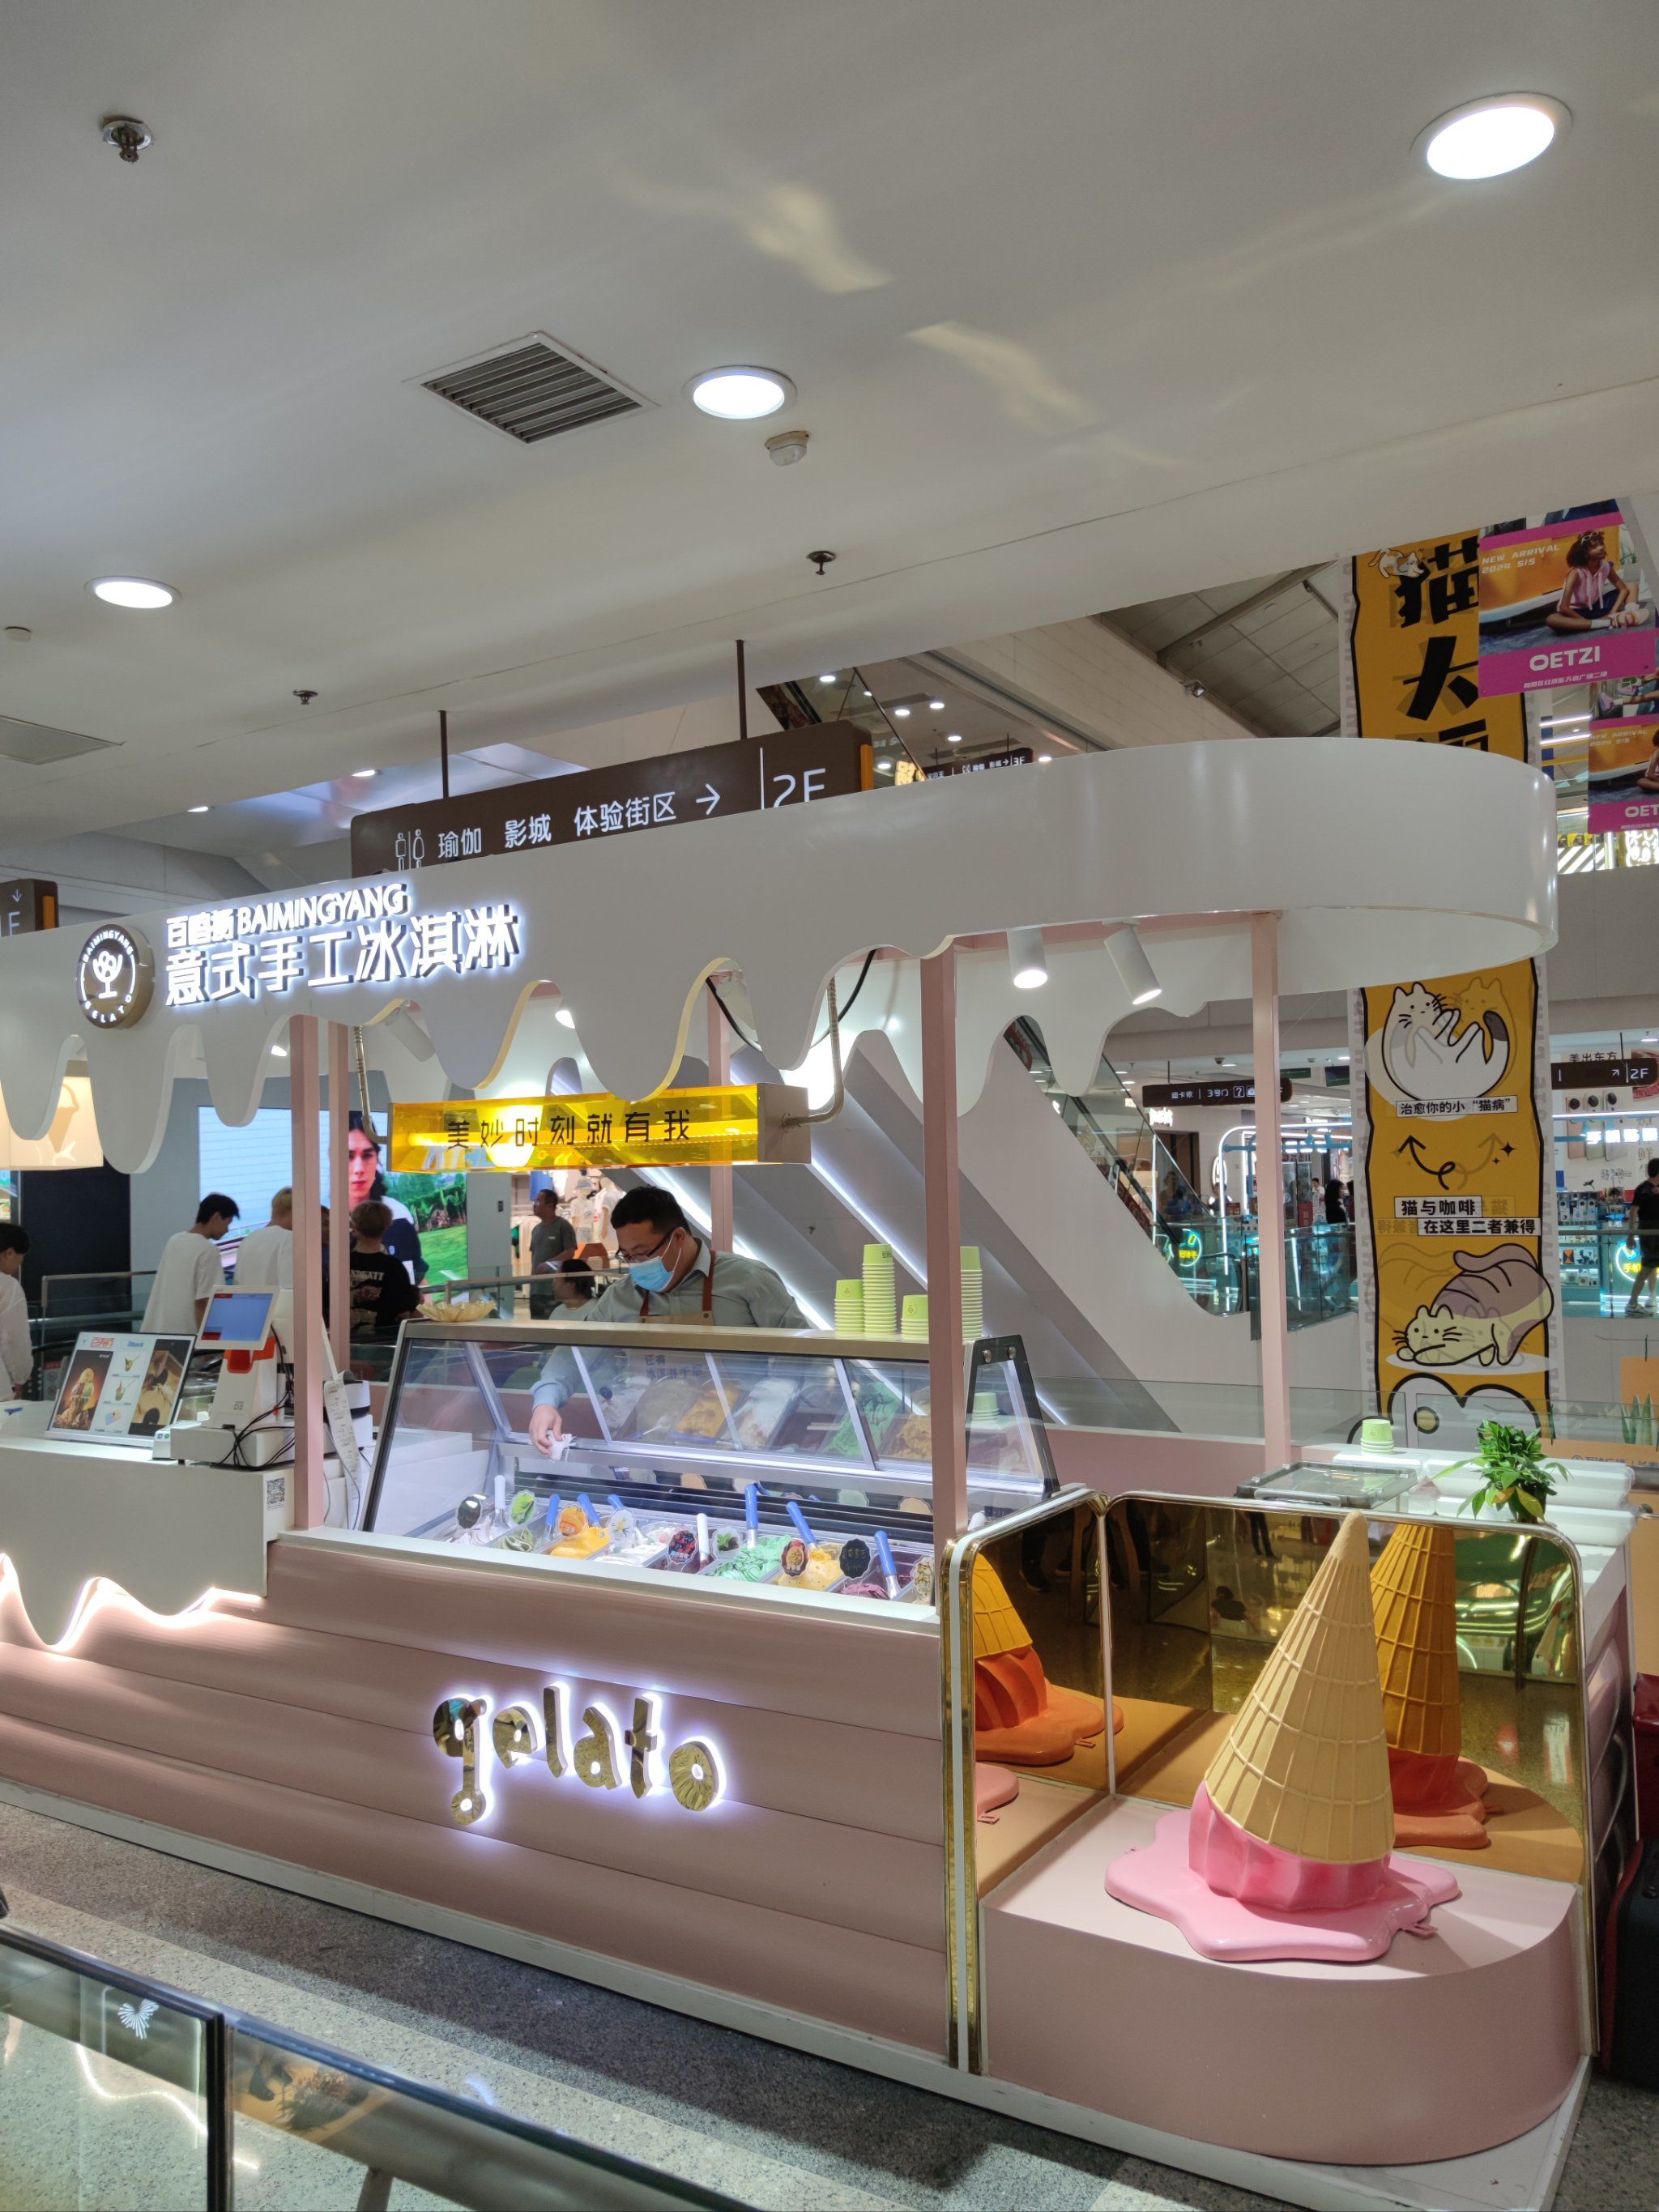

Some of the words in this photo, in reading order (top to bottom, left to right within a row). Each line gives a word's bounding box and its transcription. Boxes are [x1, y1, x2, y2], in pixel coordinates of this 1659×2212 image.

[1482, 554, 1505, 565] NEW
[1512, 543, 1560, 559] ARRIVAL
[1482, 563, 1511, 574] 2024
[1529, 646, 1601, 671] OETZI
[1013, 756, 1026, 765] 3F
[438, 828, 482, 859] 瑜伽
[505, 813, 552, 850] 影城
[574, 791, 676, 837] 体验街区
[773, 768, 826, 808] 2F
[238, 882, 407, 935] BAIMINGYANG
[83, 929, 134, 963] BAIMINGYANG
[166, 904, 520, 1007] 意式手工冰淇淋
[84, 994, 132, 1023] GELATO
[1630, 1068, 1648, 1080] 2F
[447, 1108, 690, 1150] 美妙时刻就有我
[1401, 1200, 1476, 1216] 猫与咖啡
[1424, 1219, 1536, 1235] 在这里二者兼得
[433, 1685, 719, 1825] gelato
